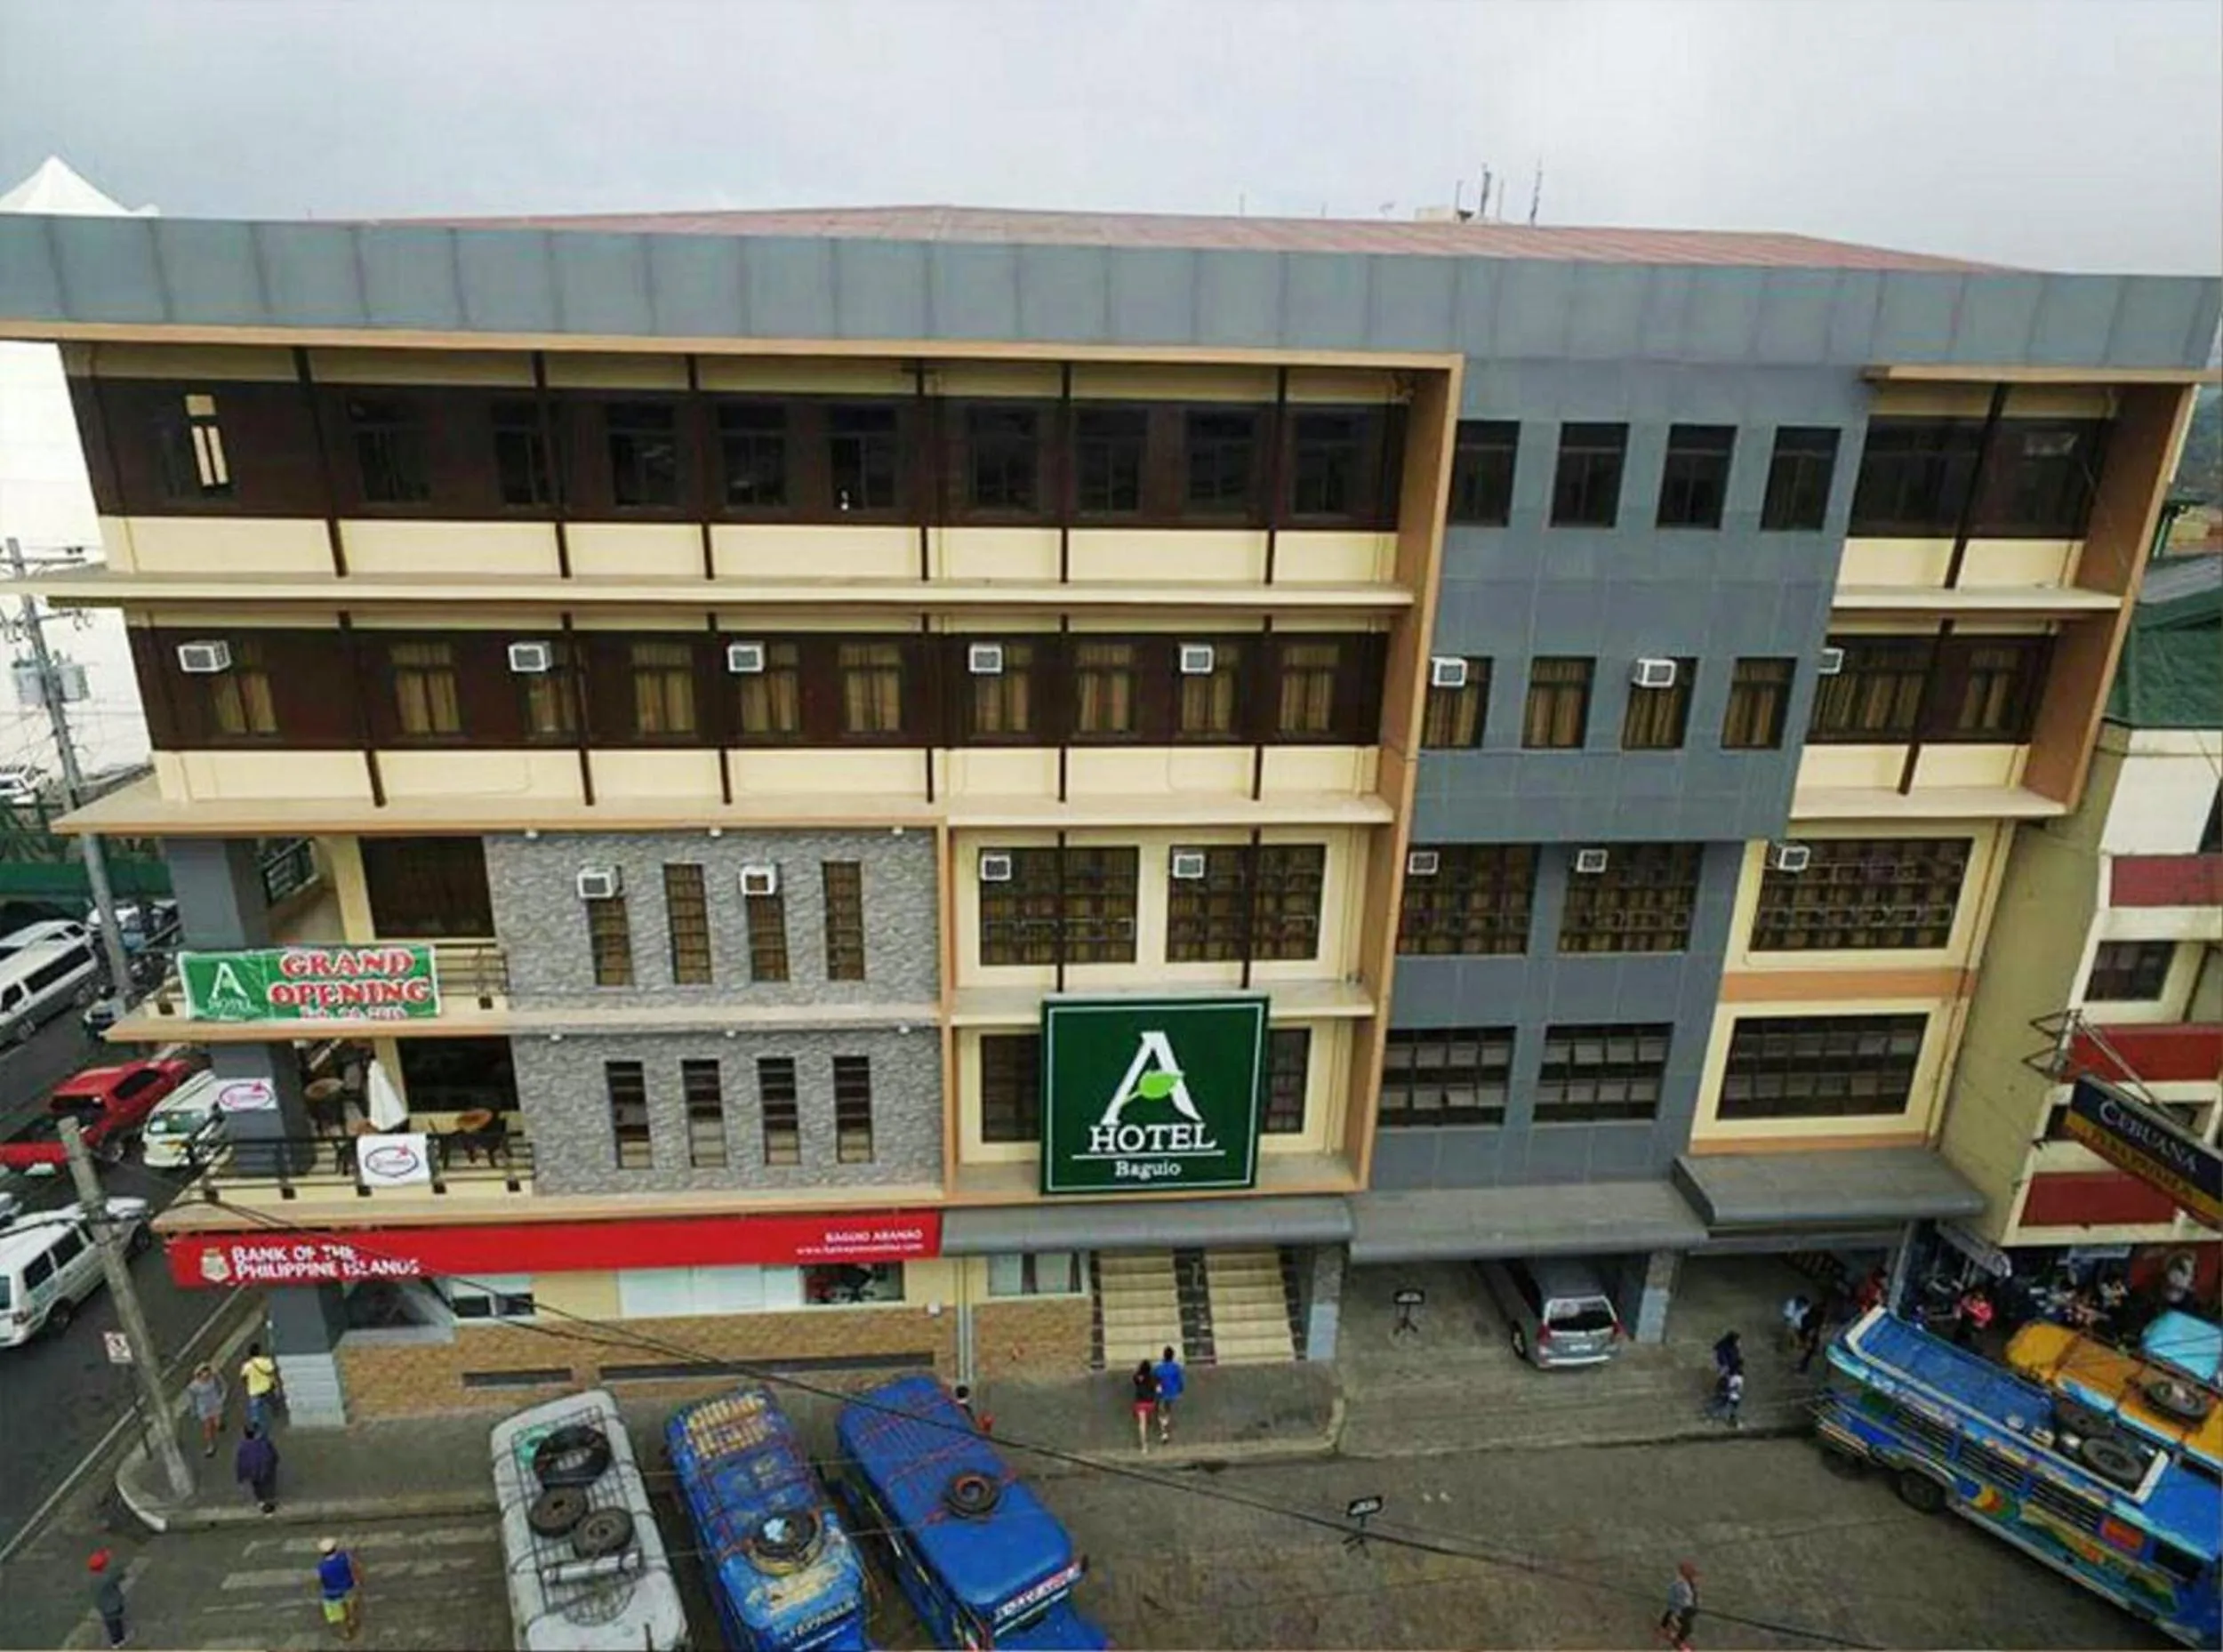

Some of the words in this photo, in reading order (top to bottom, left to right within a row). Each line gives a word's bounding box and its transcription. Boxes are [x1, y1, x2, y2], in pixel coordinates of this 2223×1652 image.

[279, 948, 415, 977] GRAND
[211, 962, 248, 998] A
[268, 978, 430, 1006] OPENING
[1101, 1030, 1203, 1126] A
[1089, 1122, 1217, 1152] HOTEL
[1115, 1159, 1182, 1181] Baguio
[231, 1246, 287, 1262] BANK
[293, 1244, 315, 1261] OF
[322, 1245, 357, 1261] THE
[234, 1261, 338, 1279] PHILIPPINE
[343, 1258, 421, 1278] ISLANDS
